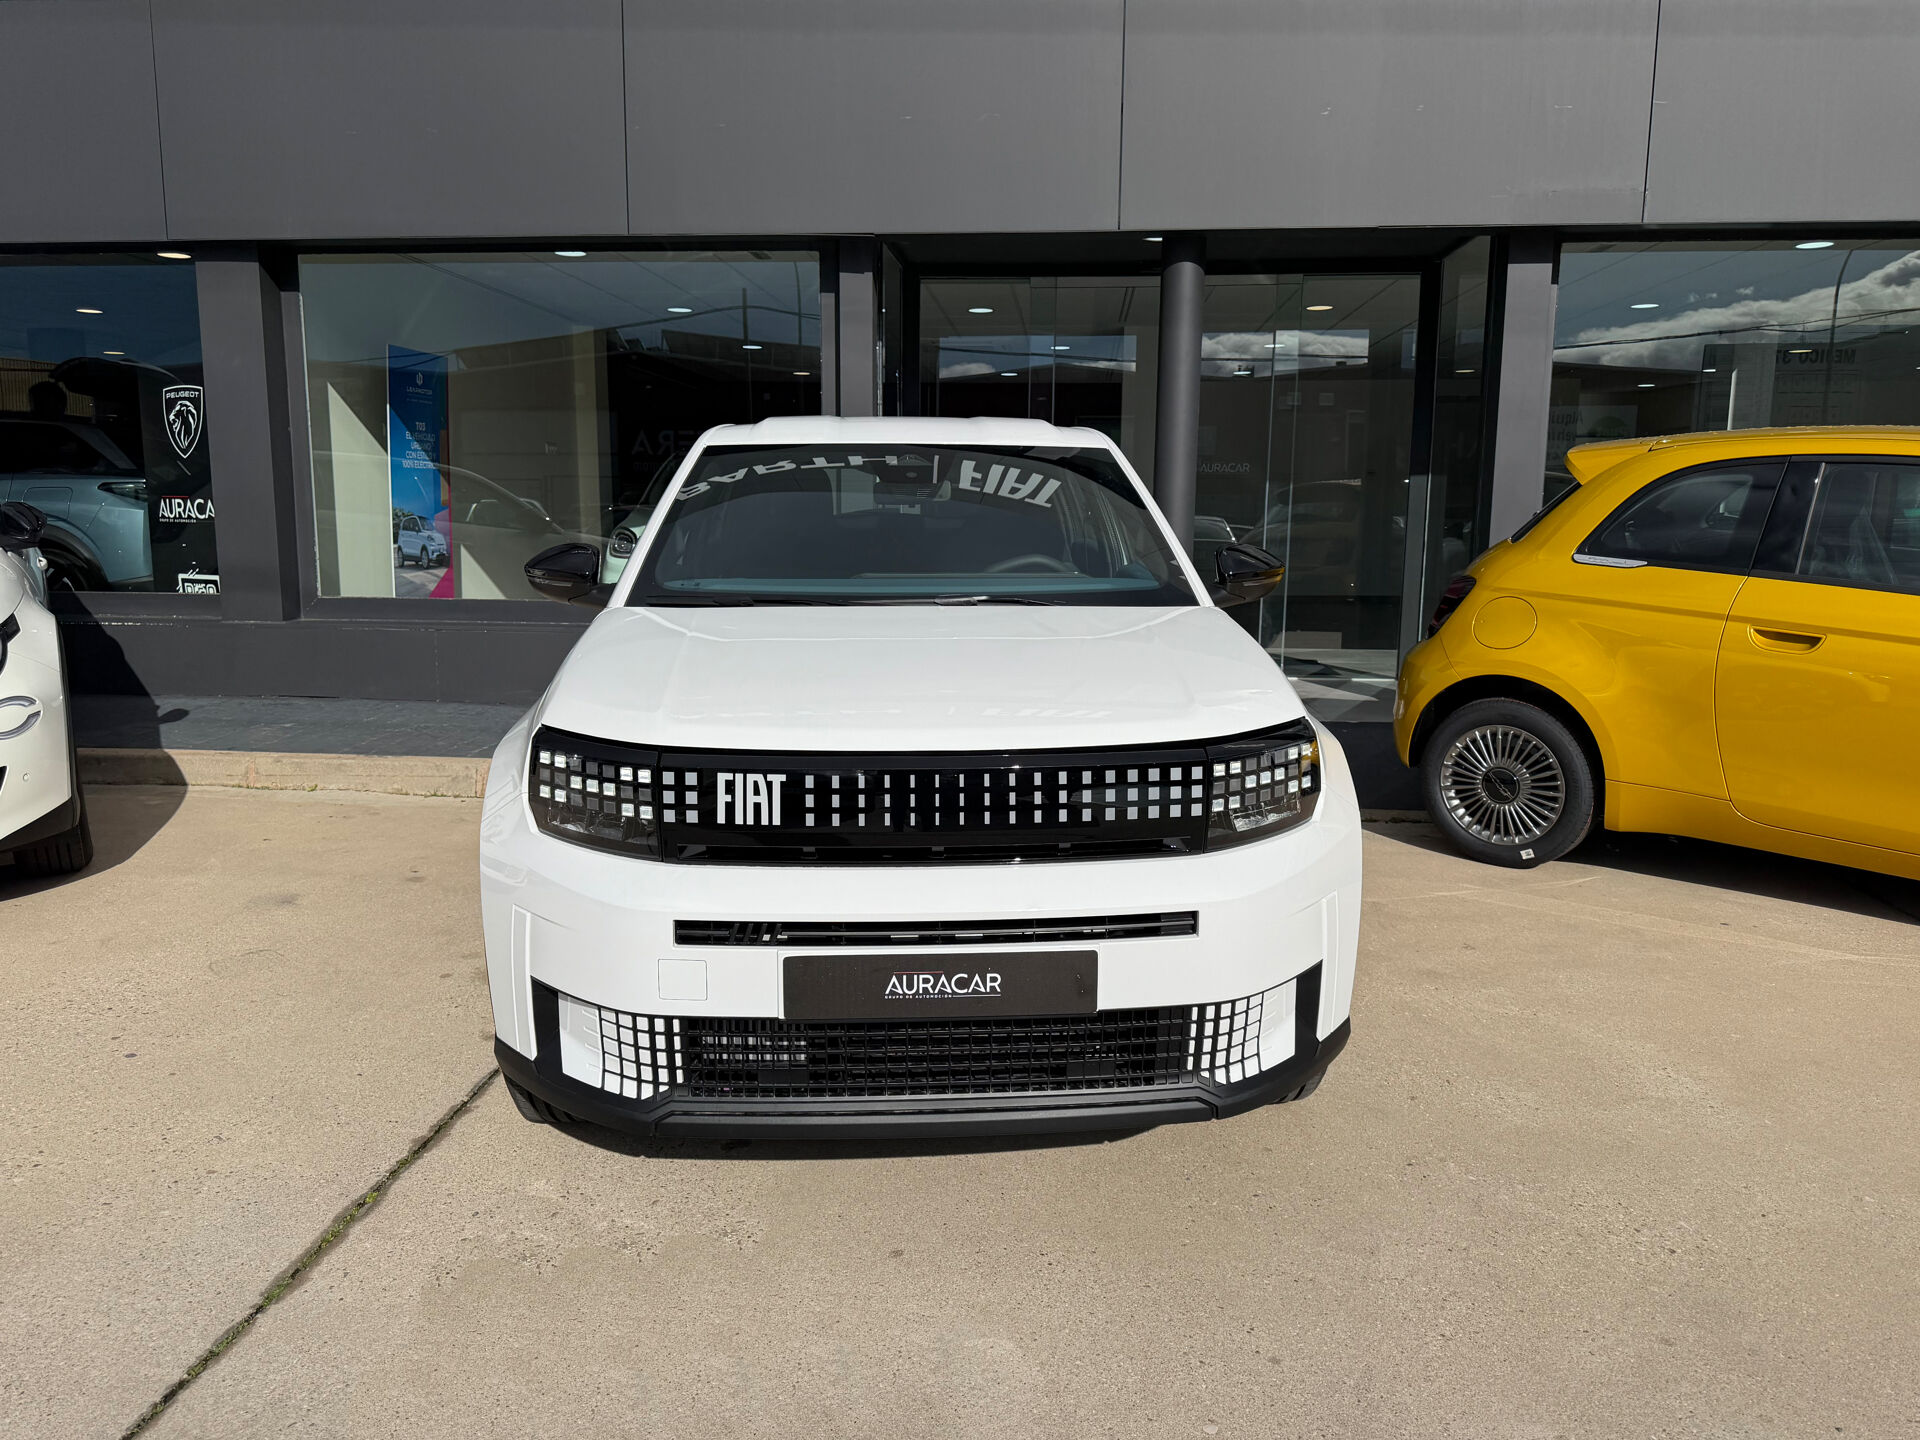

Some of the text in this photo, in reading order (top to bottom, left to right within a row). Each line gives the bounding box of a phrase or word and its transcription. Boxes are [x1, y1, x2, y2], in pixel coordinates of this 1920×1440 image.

[166, 391, 199, 399] PEUGEOT
[1200, 463, 1249, 473] AURACAR
[717, 772, 786, 826] FIAT
[885, 973, 1001, 995] AURACAR
